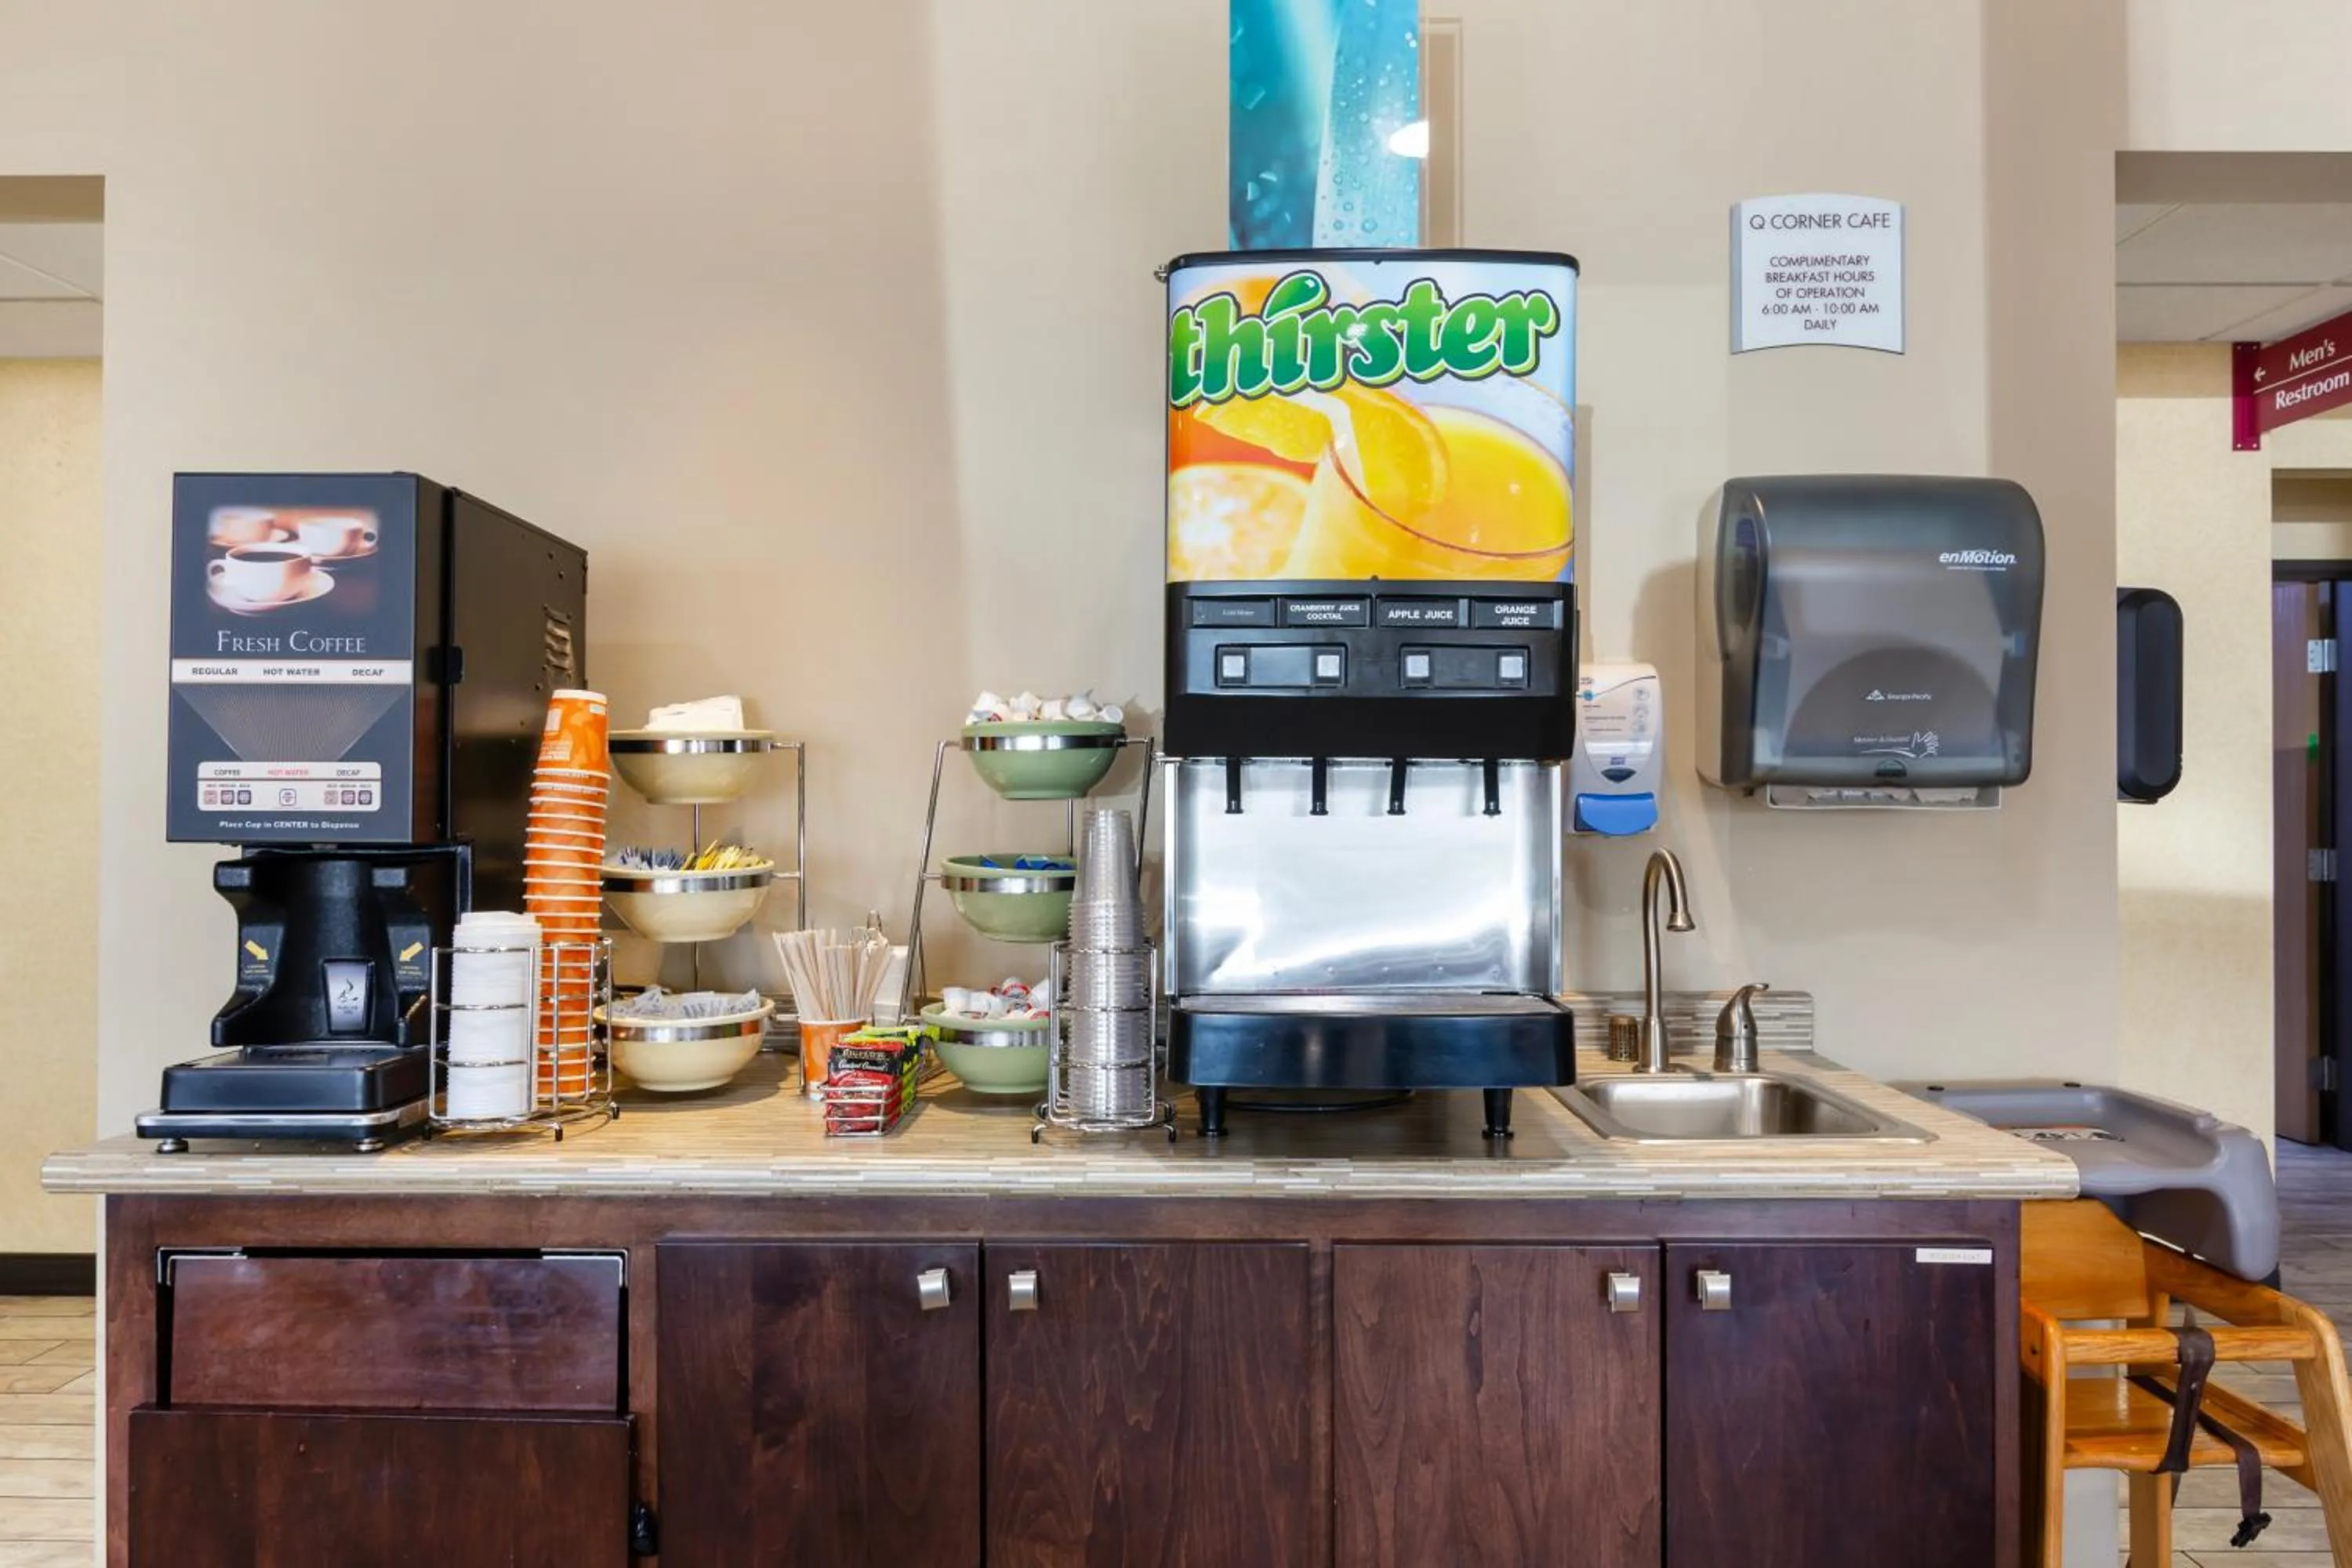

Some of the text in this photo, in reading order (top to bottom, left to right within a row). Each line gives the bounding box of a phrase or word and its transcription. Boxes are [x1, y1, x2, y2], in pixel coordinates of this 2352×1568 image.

[1749, 212, 1890, 230] Q CORNER CAFE
[1769, 255, 1870, 267] COMPLIMENTARY
[1766, 271, 1875, 283] BREAKFAST HOURS
[1776, 287, 1865, 299] OF OPERATION
[1762, 304, 1788, 314] 6:00
[1791, 303, 1811, 314] AM
[1824, 303, 1856, 314] 10:00
[1859, 303, 1879, 314] AM
[1804, 319, 1837, 330] DAILY
[1169, 270, 1560, 408] thirster
[2289, 339, 2336, 372] Men's
[2275, 371, 2350, 410] Restroom
[1939, 550, 2015, 564] enMotion
[1388, 610, 1453, 619] APPLE JUICE
[1494, 604, 1537, 614] ORANGE
[1501, 616, 1530, 625] JUICE
[192, 667, 238, 676] REGULAR
[285, 668, 321, 677] WATER
